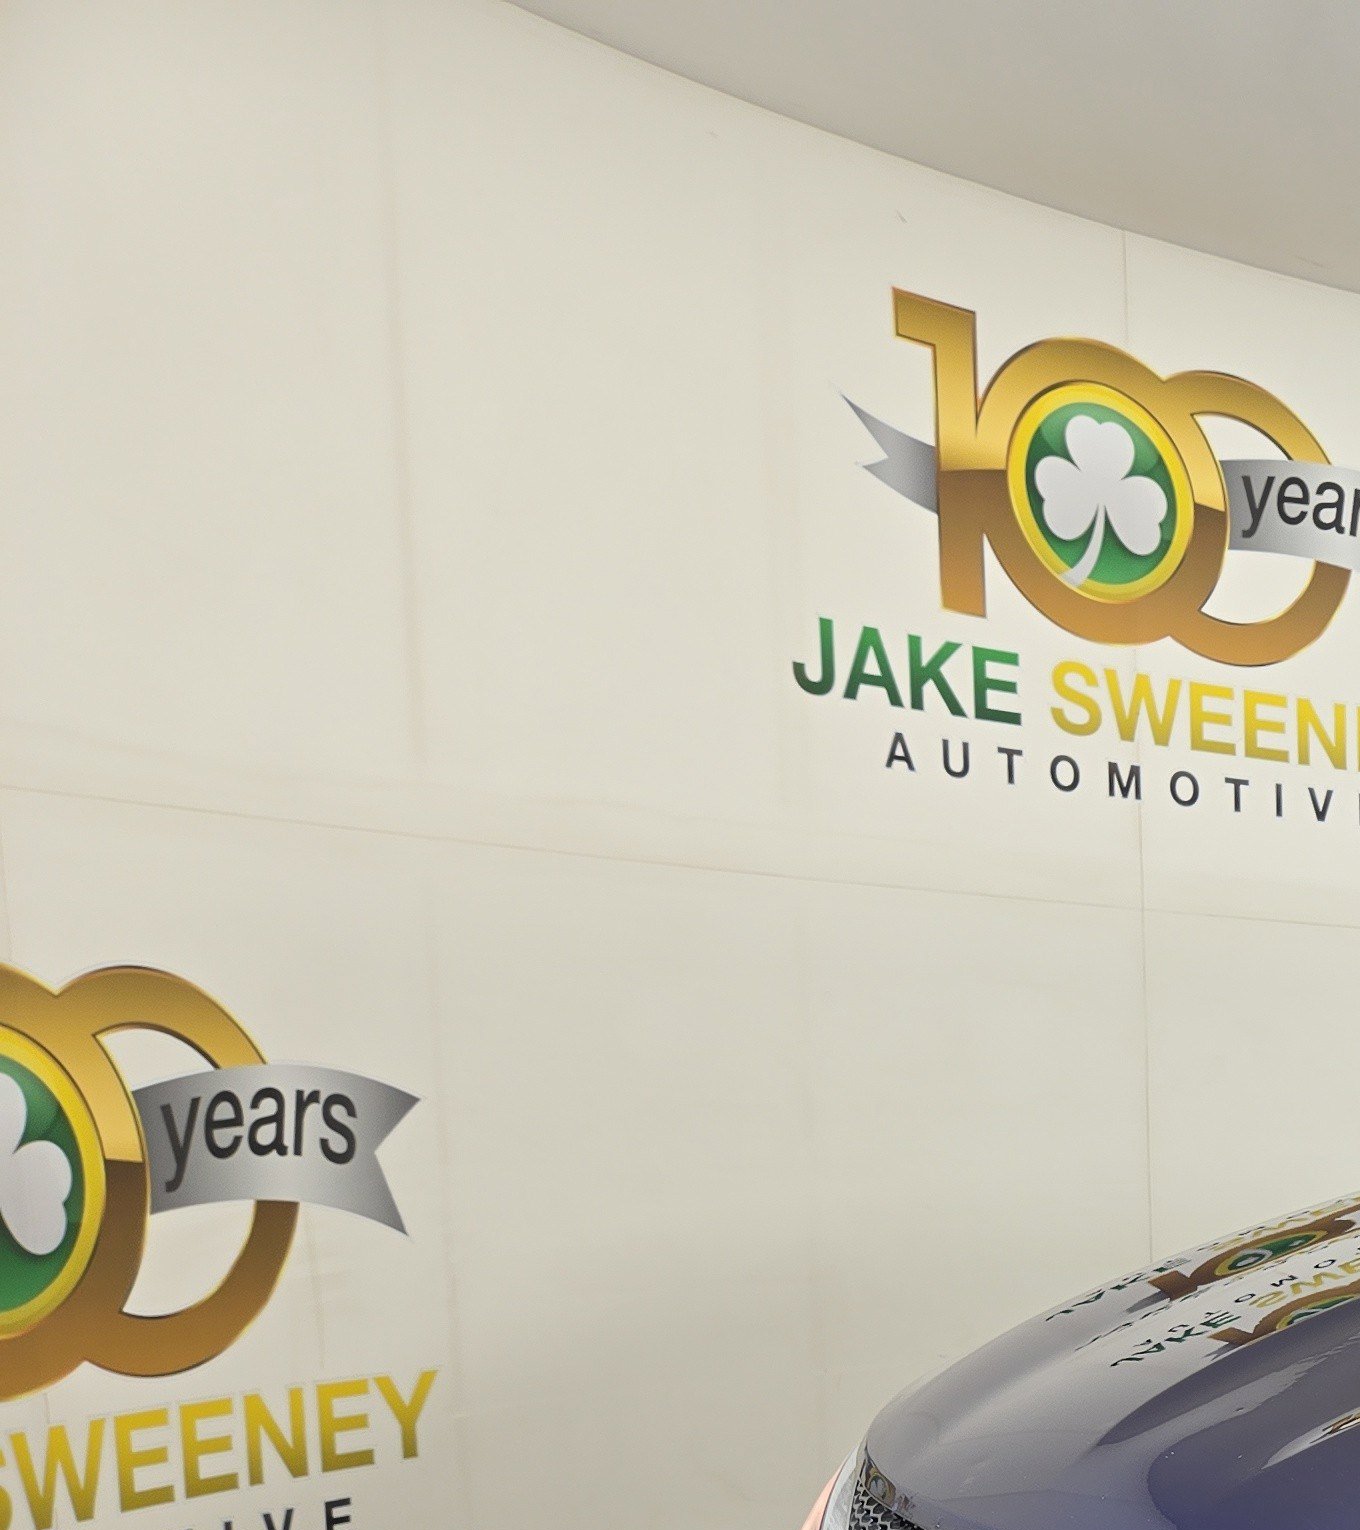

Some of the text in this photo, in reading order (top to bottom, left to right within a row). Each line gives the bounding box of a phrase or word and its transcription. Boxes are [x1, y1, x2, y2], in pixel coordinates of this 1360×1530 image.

[891, 286, 1353, 667] 100
[792, 615, 1023, 727] JAKE
[159, 1084, 358, 1193] years
